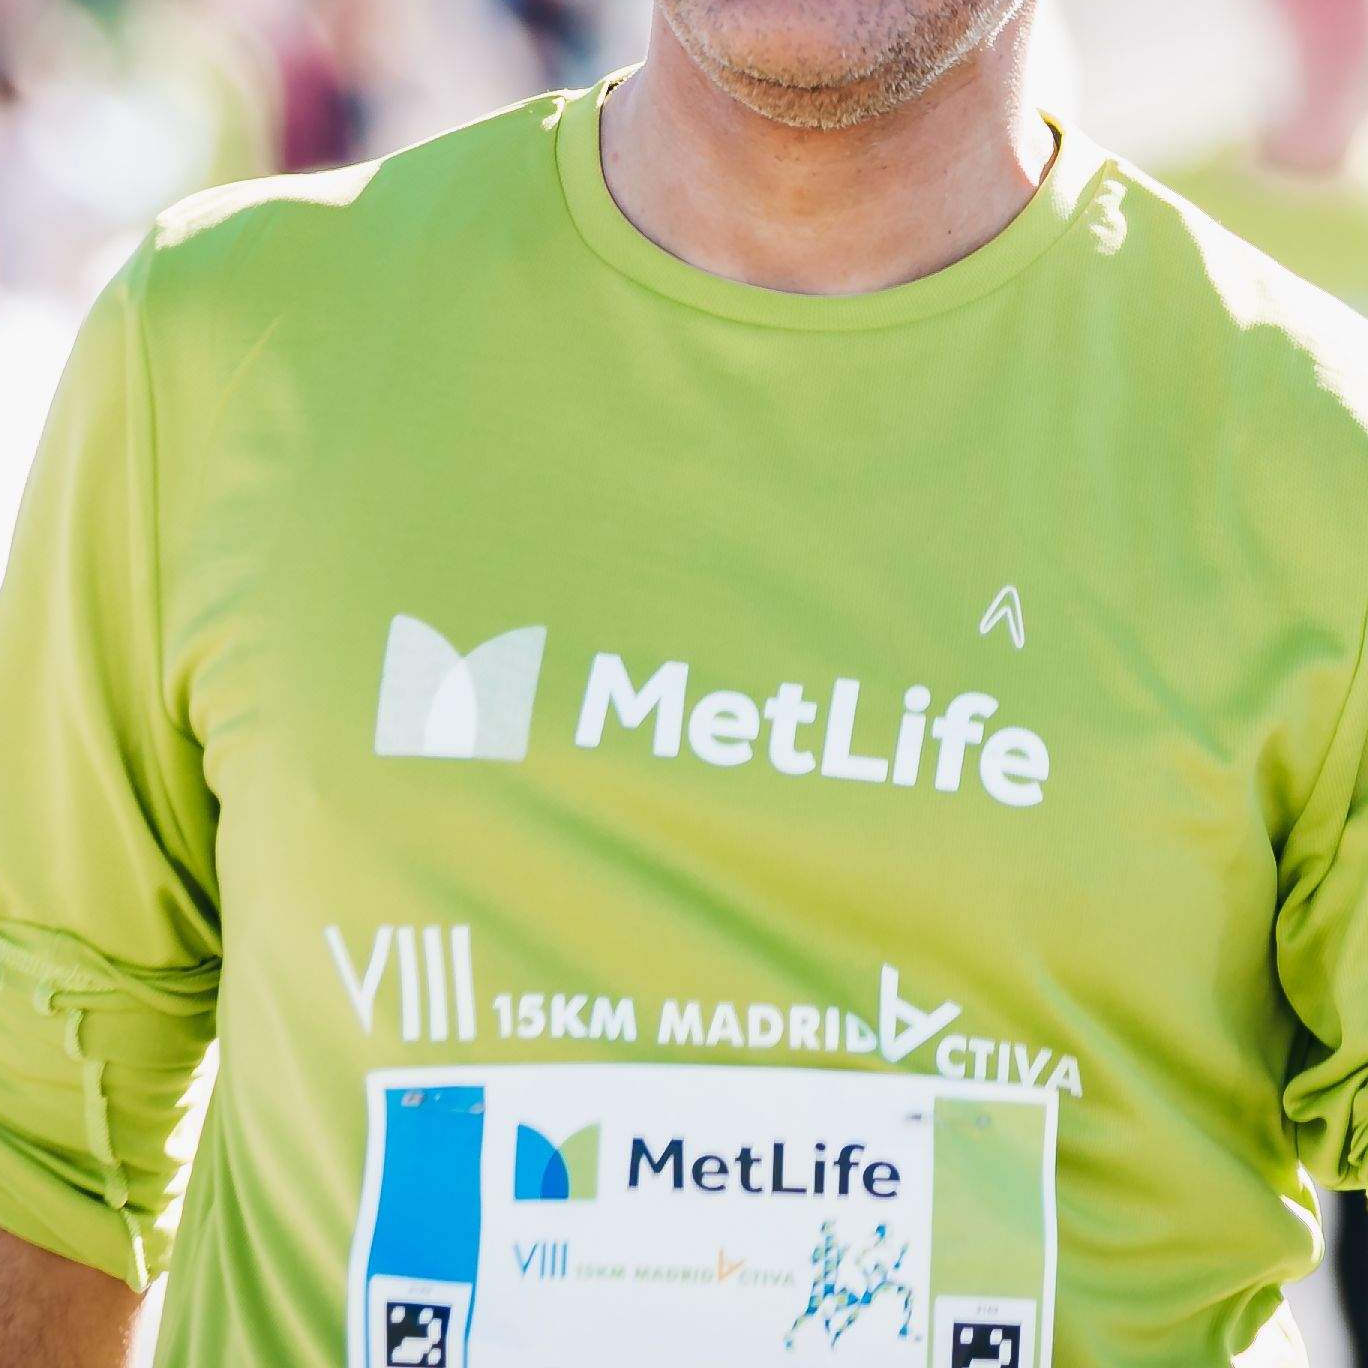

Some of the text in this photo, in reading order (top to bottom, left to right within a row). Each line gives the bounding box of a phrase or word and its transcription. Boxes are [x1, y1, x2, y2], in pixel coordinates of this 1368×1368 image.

[575, 651, 1051, 808] MetLife
[323, 924, 477, 1042] VIII
[492, 993, 638, 1040] 15KM
[628, 1135, 902, 1199] MetLife
[513, 1240, 569, 1281] VIII
